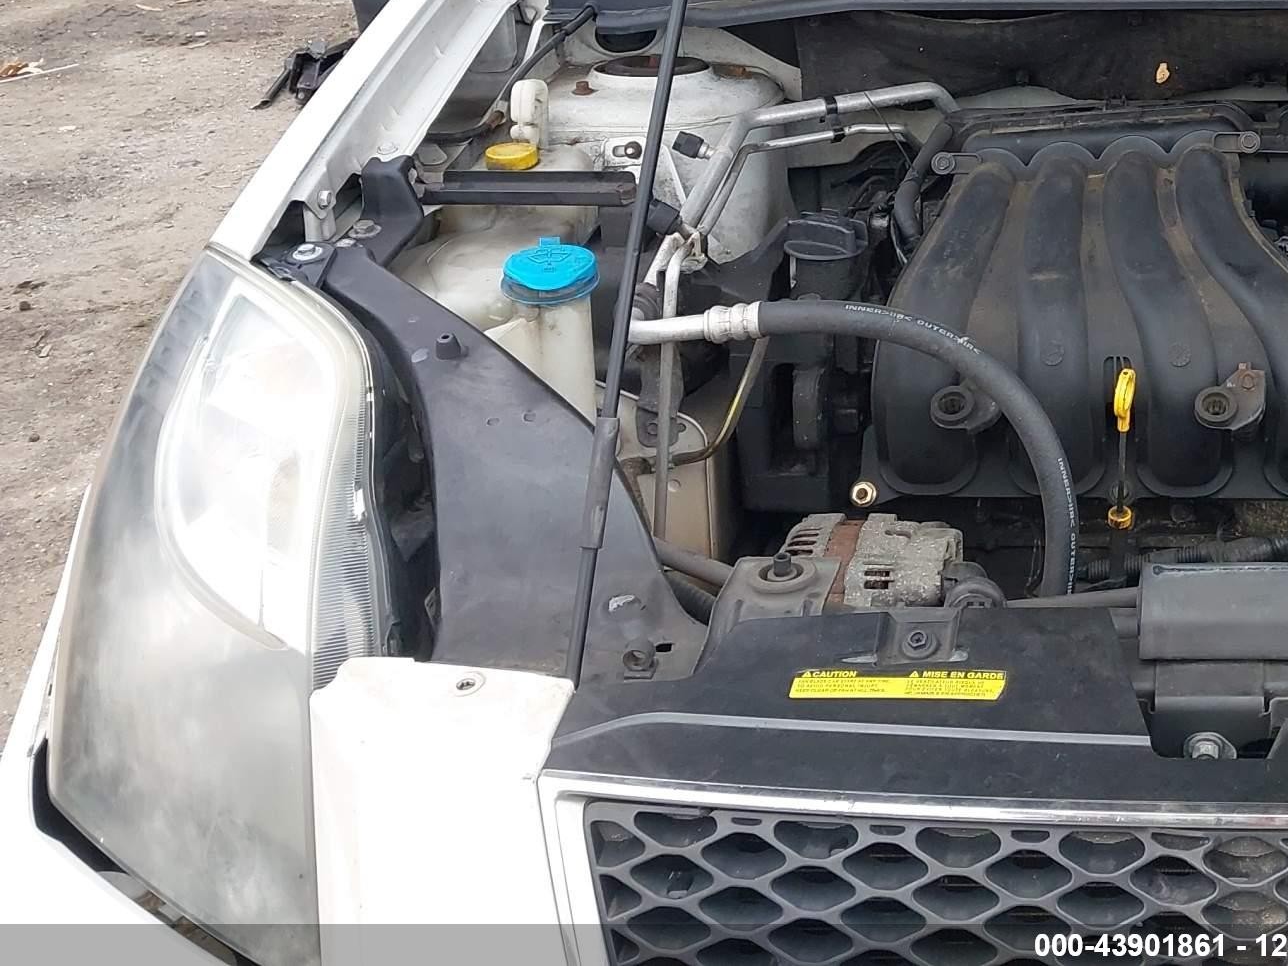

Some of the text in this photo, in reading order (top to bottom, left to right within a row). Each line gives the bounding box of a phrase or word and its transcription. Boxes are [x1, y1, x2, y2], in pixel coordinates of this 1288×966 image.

[812, 670, 858, 678] CAUTION
[922, 670, 1004, 680] MISE EN GARDE
